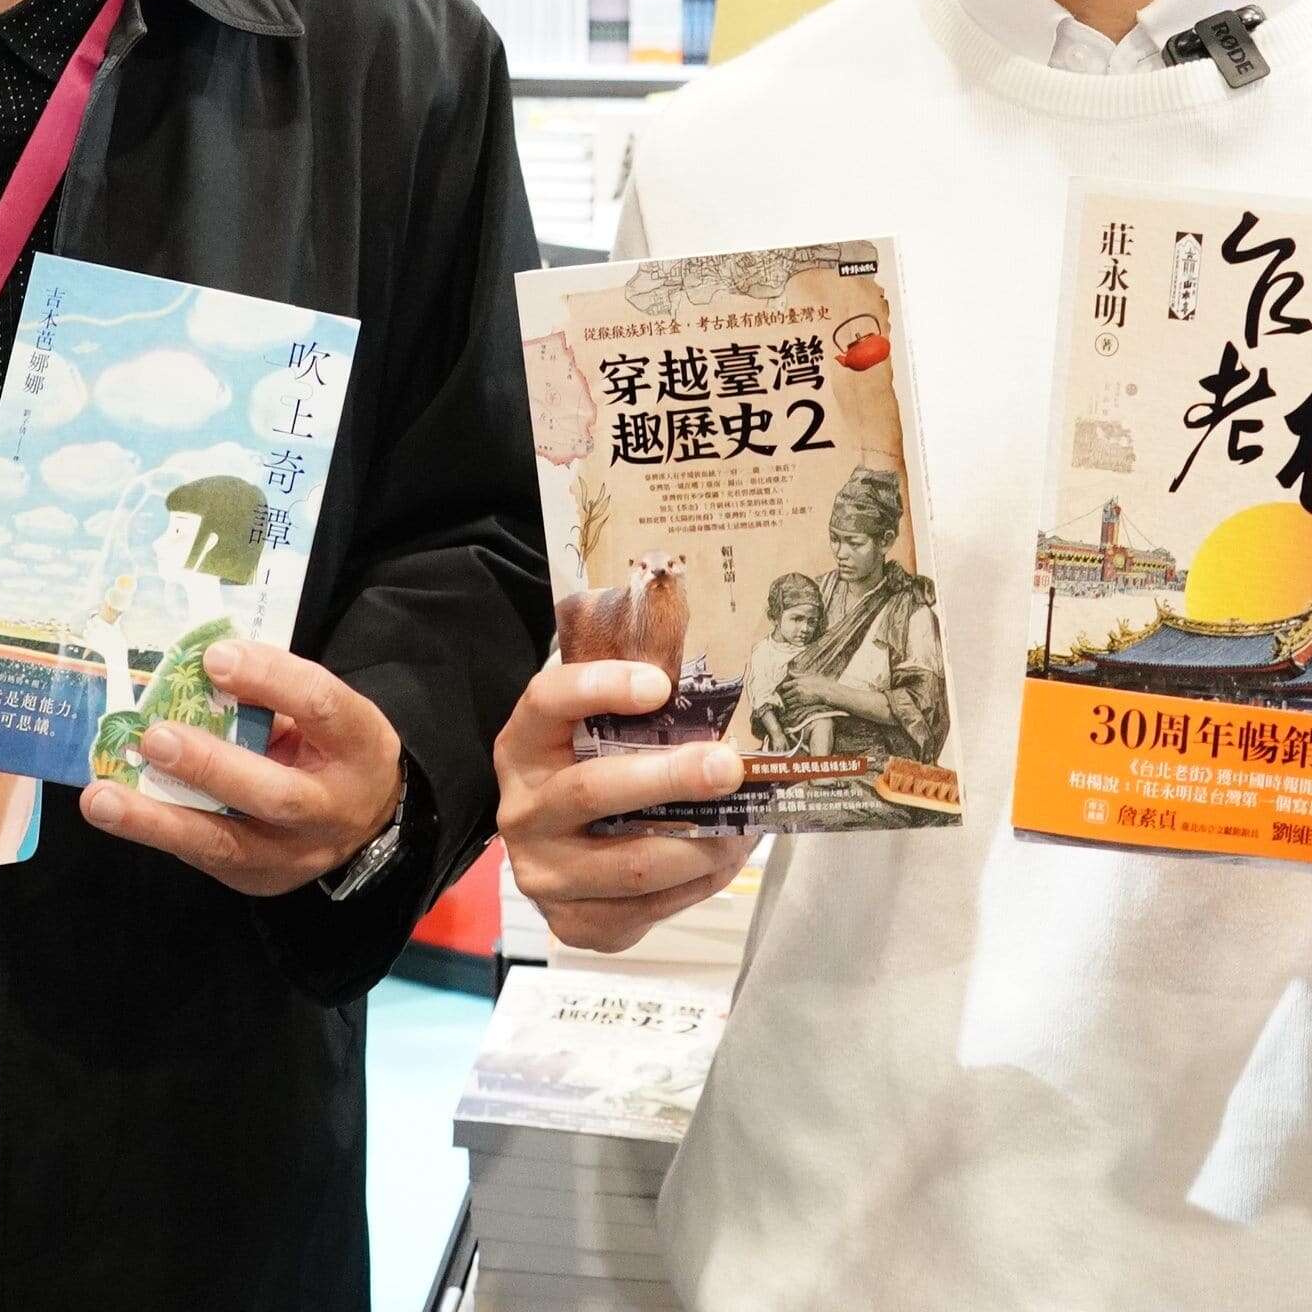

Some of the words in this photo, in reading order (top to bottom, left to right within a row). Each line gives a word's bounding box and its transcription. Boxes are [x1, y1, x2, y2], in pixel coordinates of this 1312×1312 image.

[1094, 222, 1135, 328] 莊永明
[24, 287, 66, 396] 吉本芭娜娜
[599, 335, 825, 407] 穿越臺灣
[247, 340, 332, 551] 吹上奇譚
[608, 397, 837, 468] 趣歷史2
